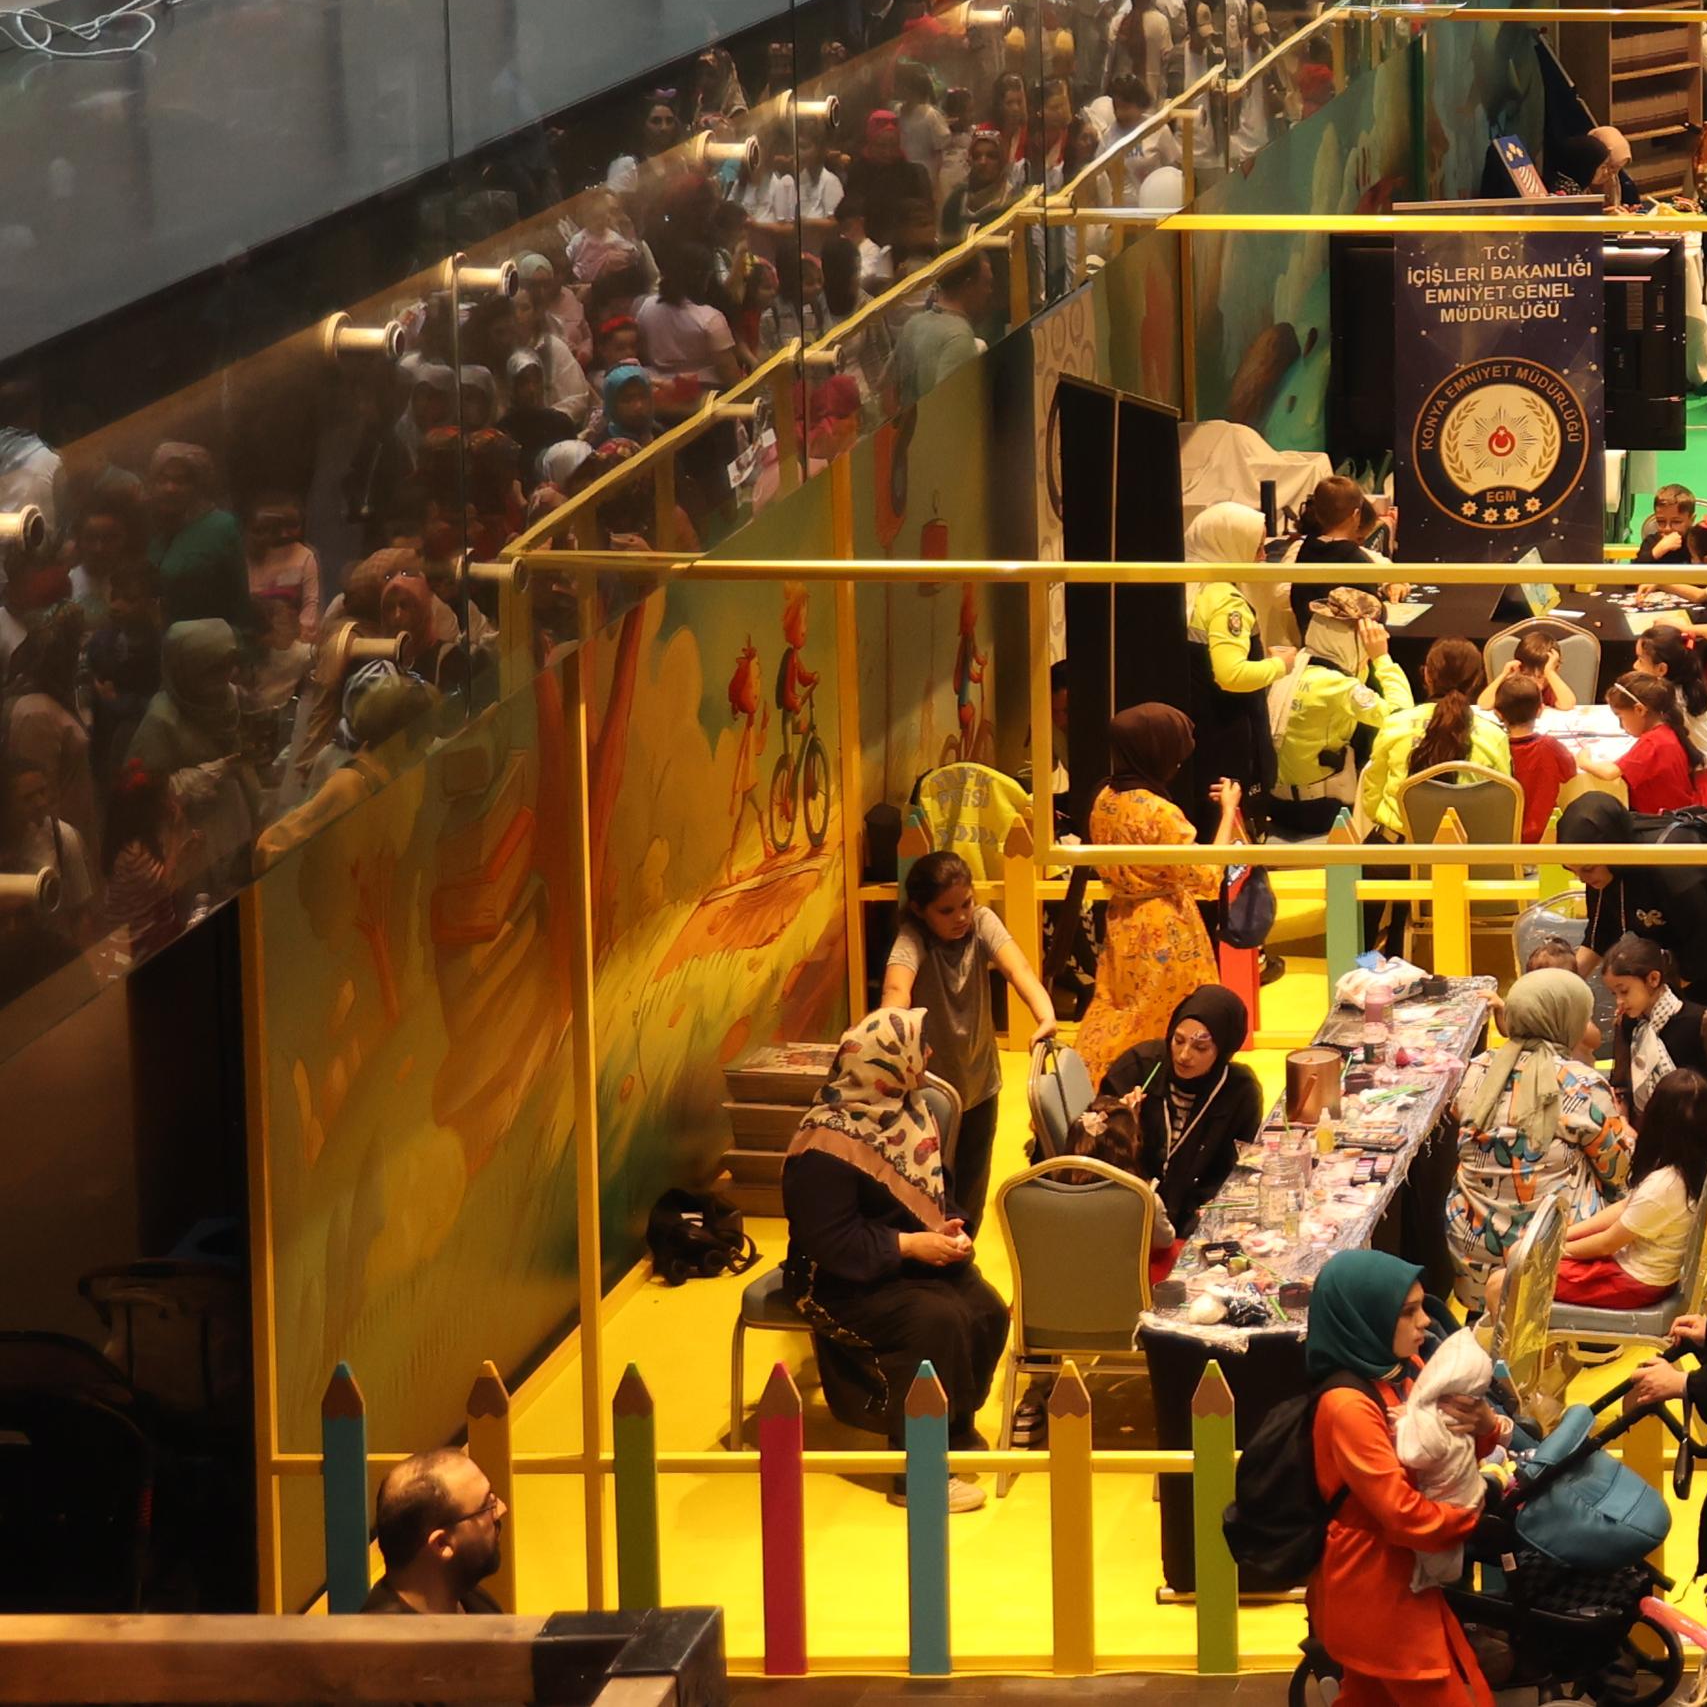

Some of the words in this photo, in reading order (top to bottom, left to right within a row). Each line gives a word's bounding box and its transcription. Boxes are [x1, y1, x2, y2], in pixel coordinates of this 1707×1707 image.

[1483, 245, 1516, 260] T.C.
[1407, 261, 1485, 288] İÇİŞLERİ
[1490, 256, 1592, 281] BAKANLIĞI
[1425, 283, 1506, 304] EMNİYET
[1511, 282, 1575, 301] GENEL
[1440, 299, 1560, 323] MÜDÜRLÜĞÜ
[1421, 399, 1448, 451] KONYA
[1444, 365, 1513, 399] EMNİYET
[1515, 366, 1583, 443] MÜDÜRLÜĞÜ
[1485, 489, 1517, 504] EGM
